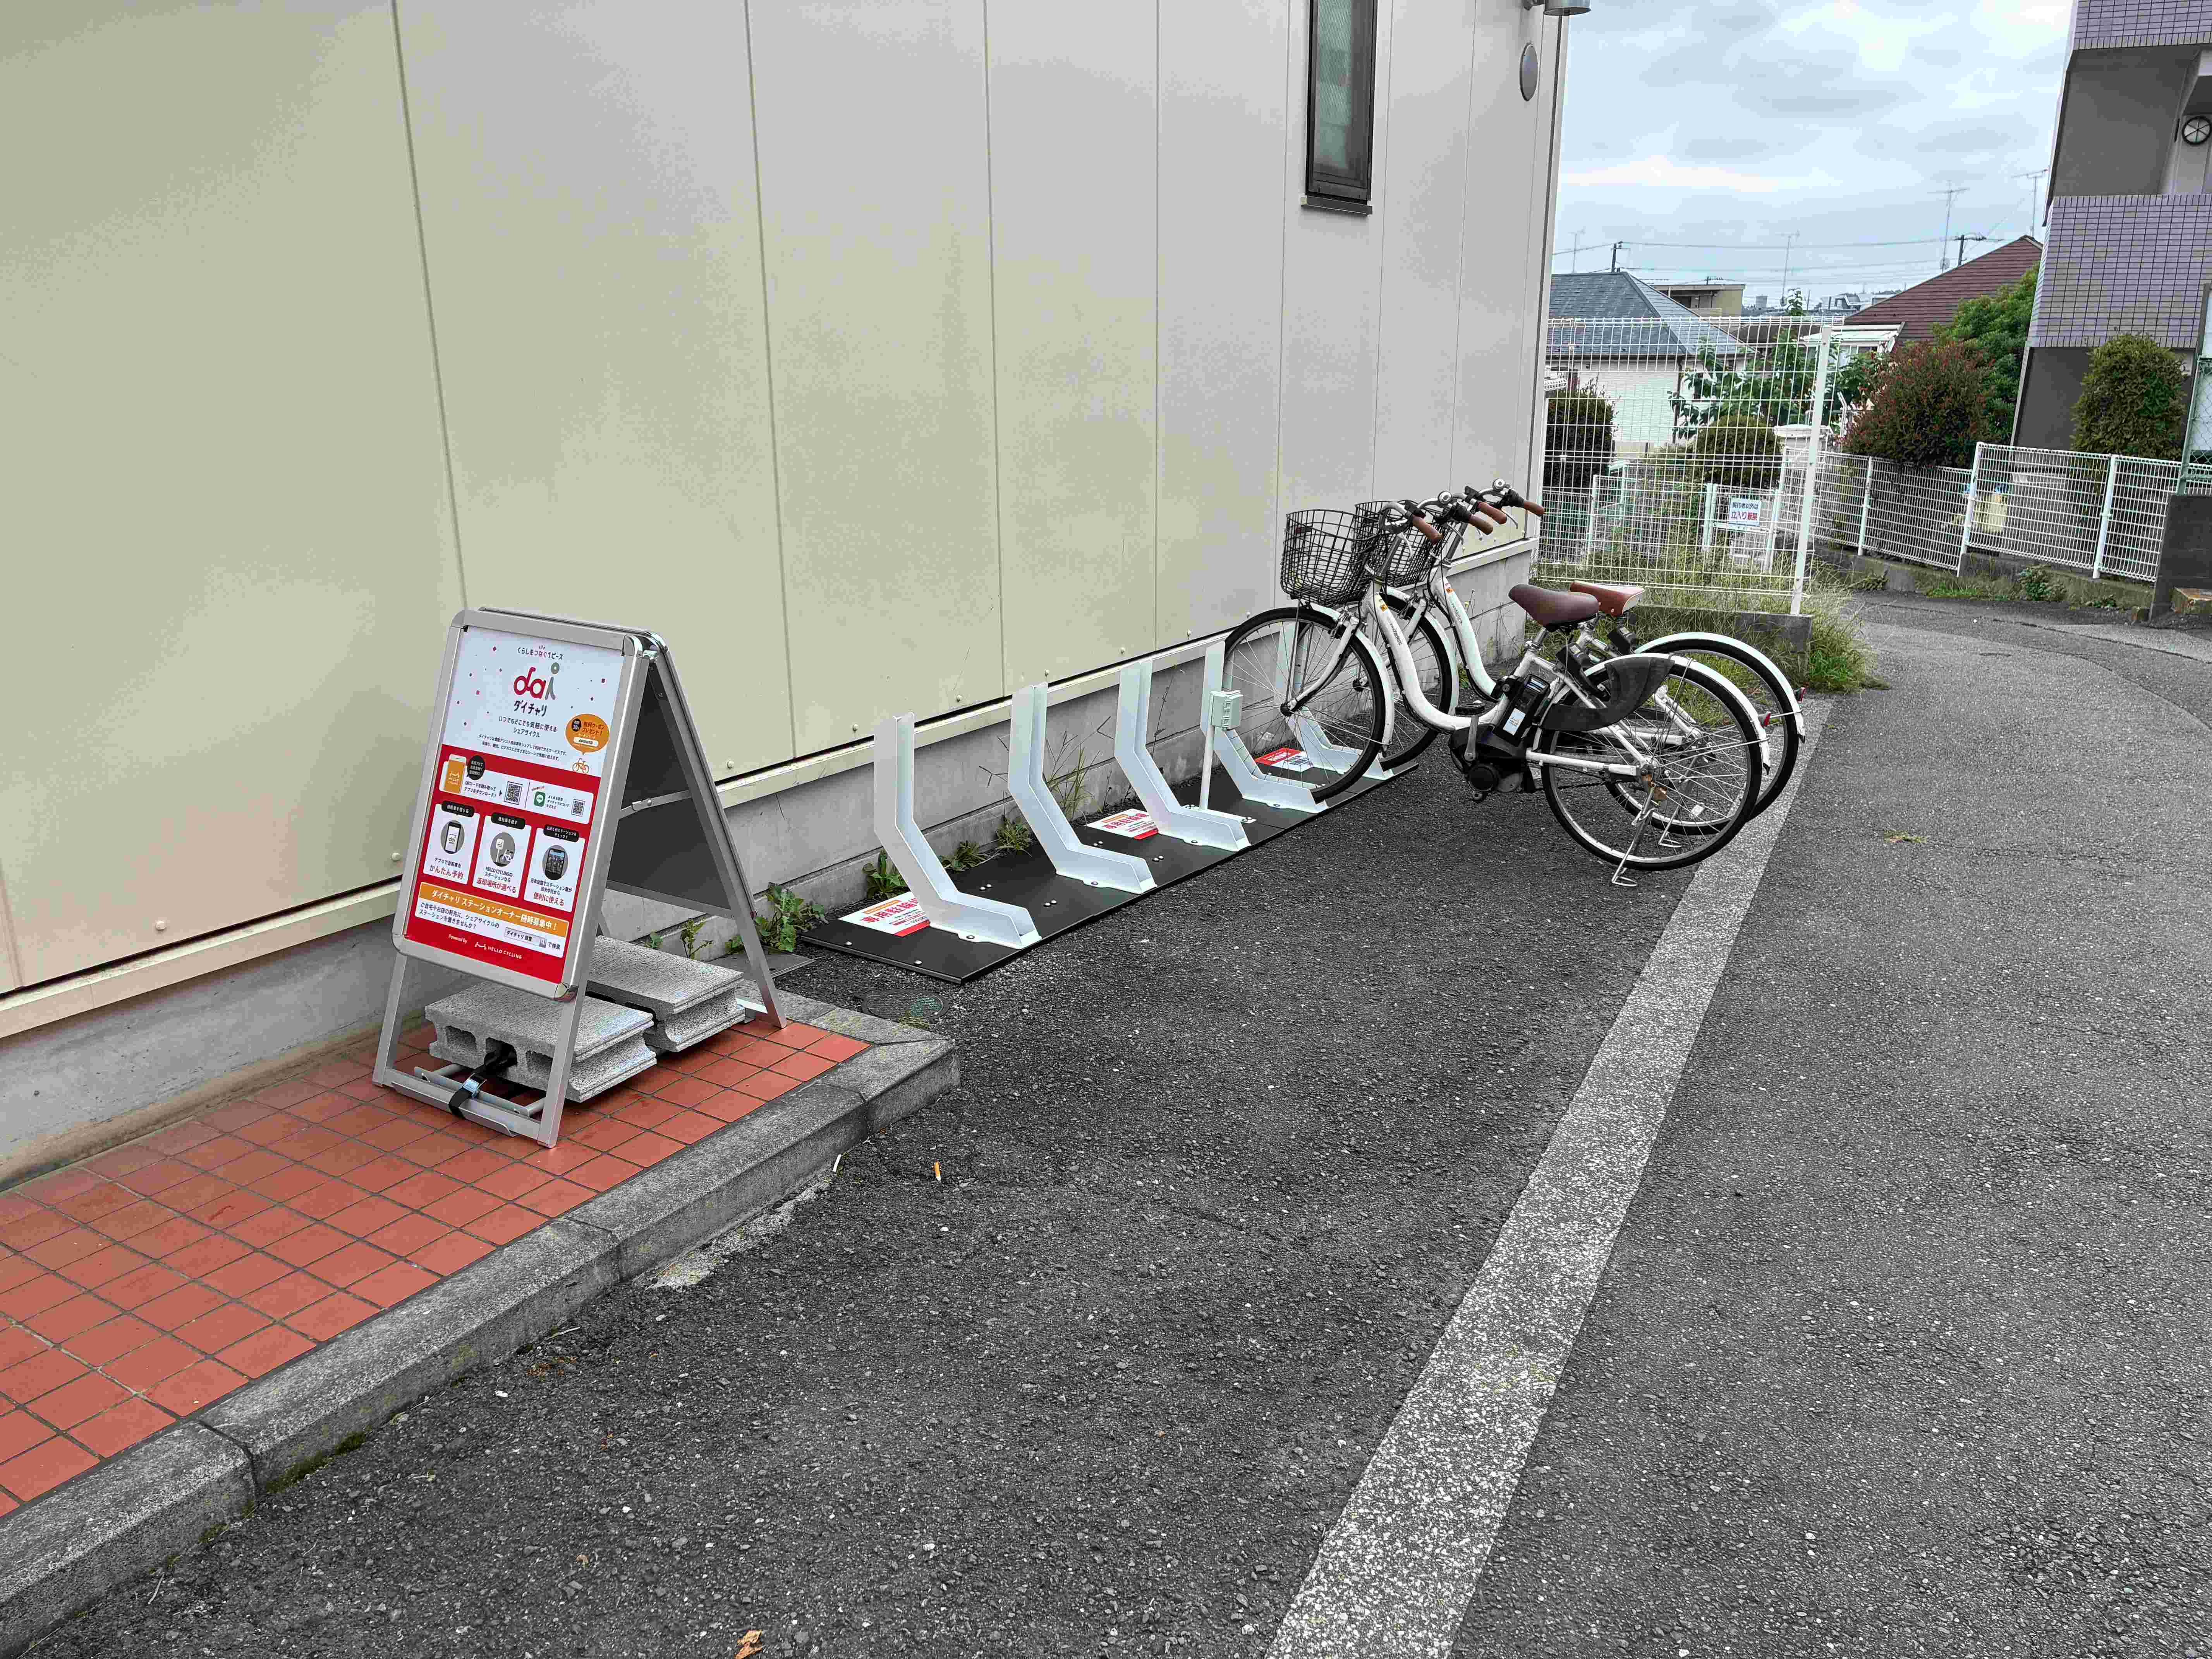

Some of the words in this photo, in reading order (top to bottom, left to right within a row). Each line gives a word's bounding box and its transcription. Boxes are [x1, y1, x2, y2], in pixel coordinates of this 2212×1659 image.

[1731, 511, 1758, 520] 立入り厳禁
[514, 662, 560, 700] dai
[514, 700, 547, 716] ダイチャリ
[498, 716, 557, 732] いつでもどこでも気軽に使える
[513, 727, 540, 738] シェアサイクル
[434, 857, 461, 868] アプリで自転車を
[429, 864, 464, 879] かんたん予約
[484, 872, 511, 883] ステーションなら
[476, 878, 516, 893] 返却場所が選べる
[530, 878, 572, 893] 日本全国でステーション数が
[540, 886, 560, 896] 拡大中だから
[432, 890, 460, 903] ダイチャリ
[533, 892, 564, 906] 便利に使える
[419, 908, 477, 930] ステーションを置きませんか？
[420, 902, 500, 929] ご自宅やお店の軒先に、シェアサイクルの
[448, 934, 463, 942] Powered
[503, 950, 522, 959] CYCLING
[506, 930, 524, 939] ダイチャリ
[548, 942, 561, 950] で検索
